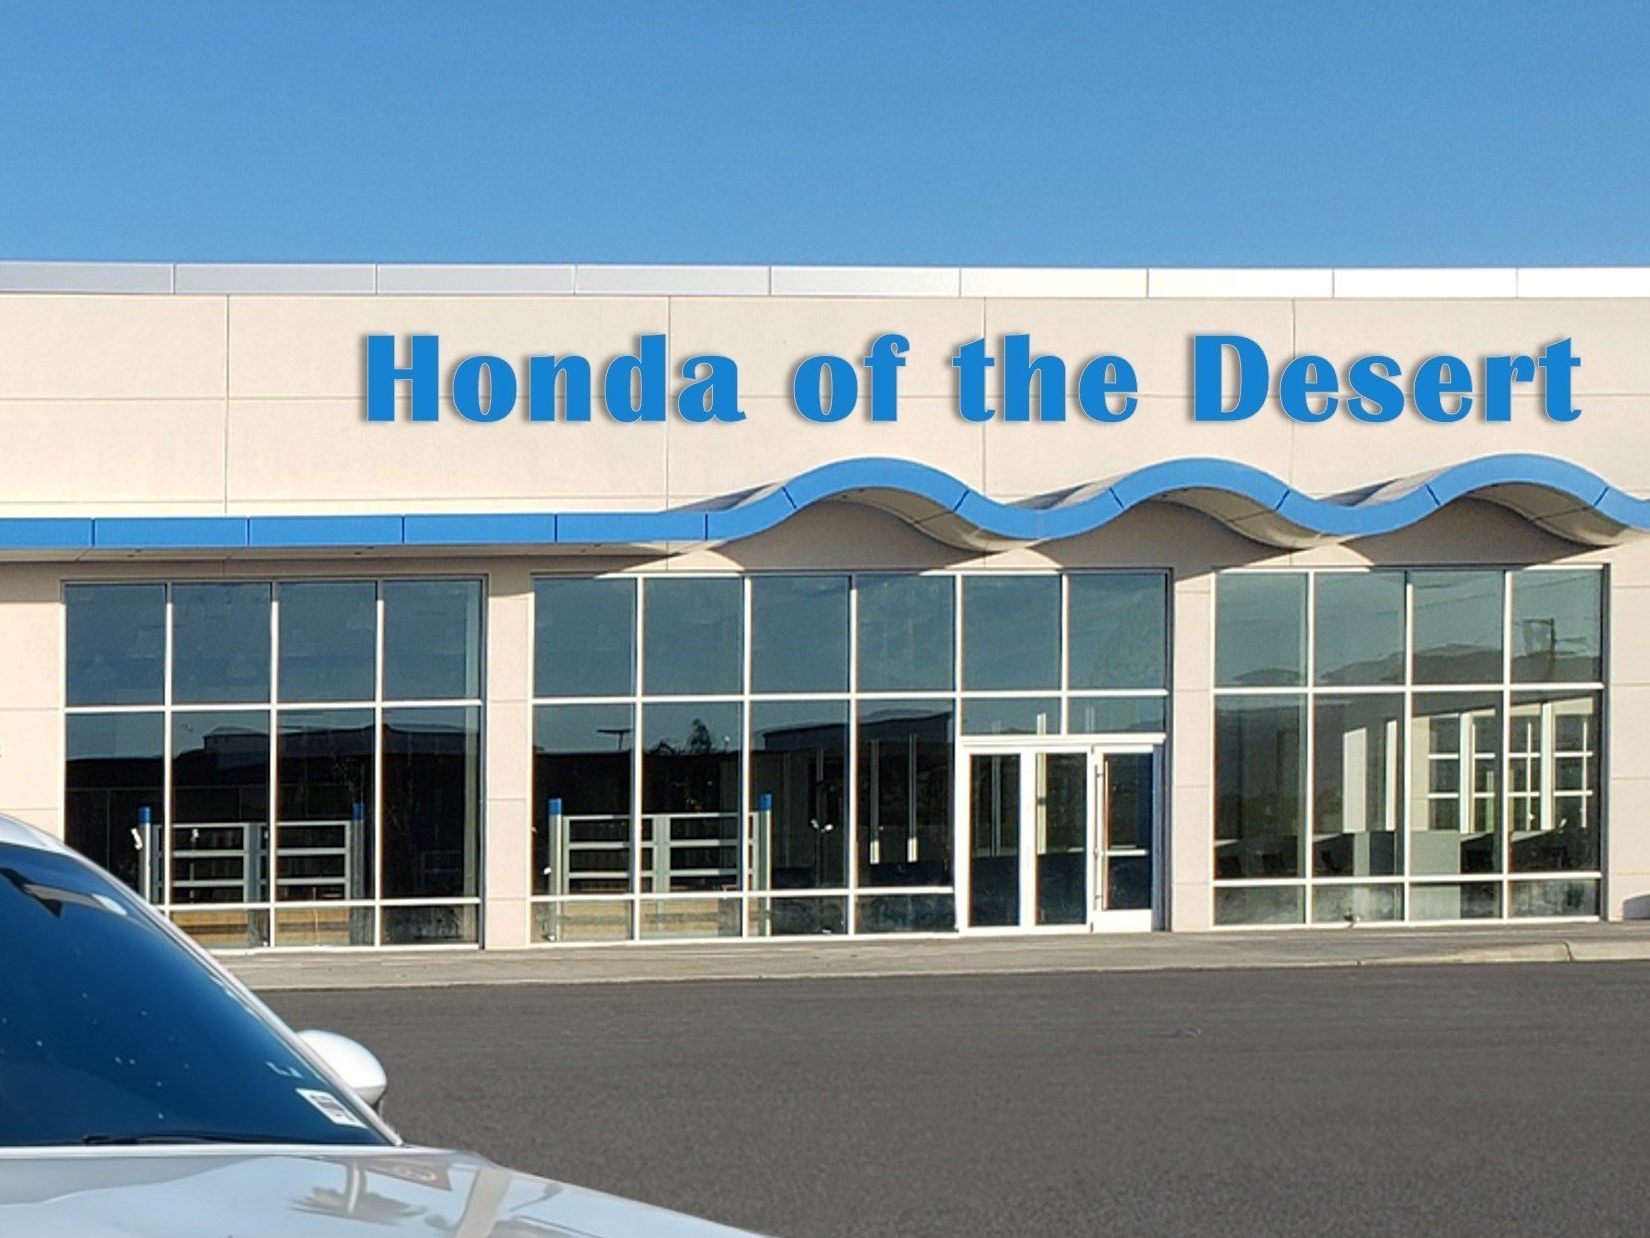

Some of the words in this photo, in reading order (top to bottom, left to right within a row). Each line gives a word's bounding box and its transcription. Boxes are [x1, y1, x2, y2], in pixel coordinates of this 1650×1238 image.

[365, 333, 748, 423] Honda
[792, 332, 911, 423] of
[951, 332, 1138, 423] the
[1192, 335, 1583, 423] Desert
